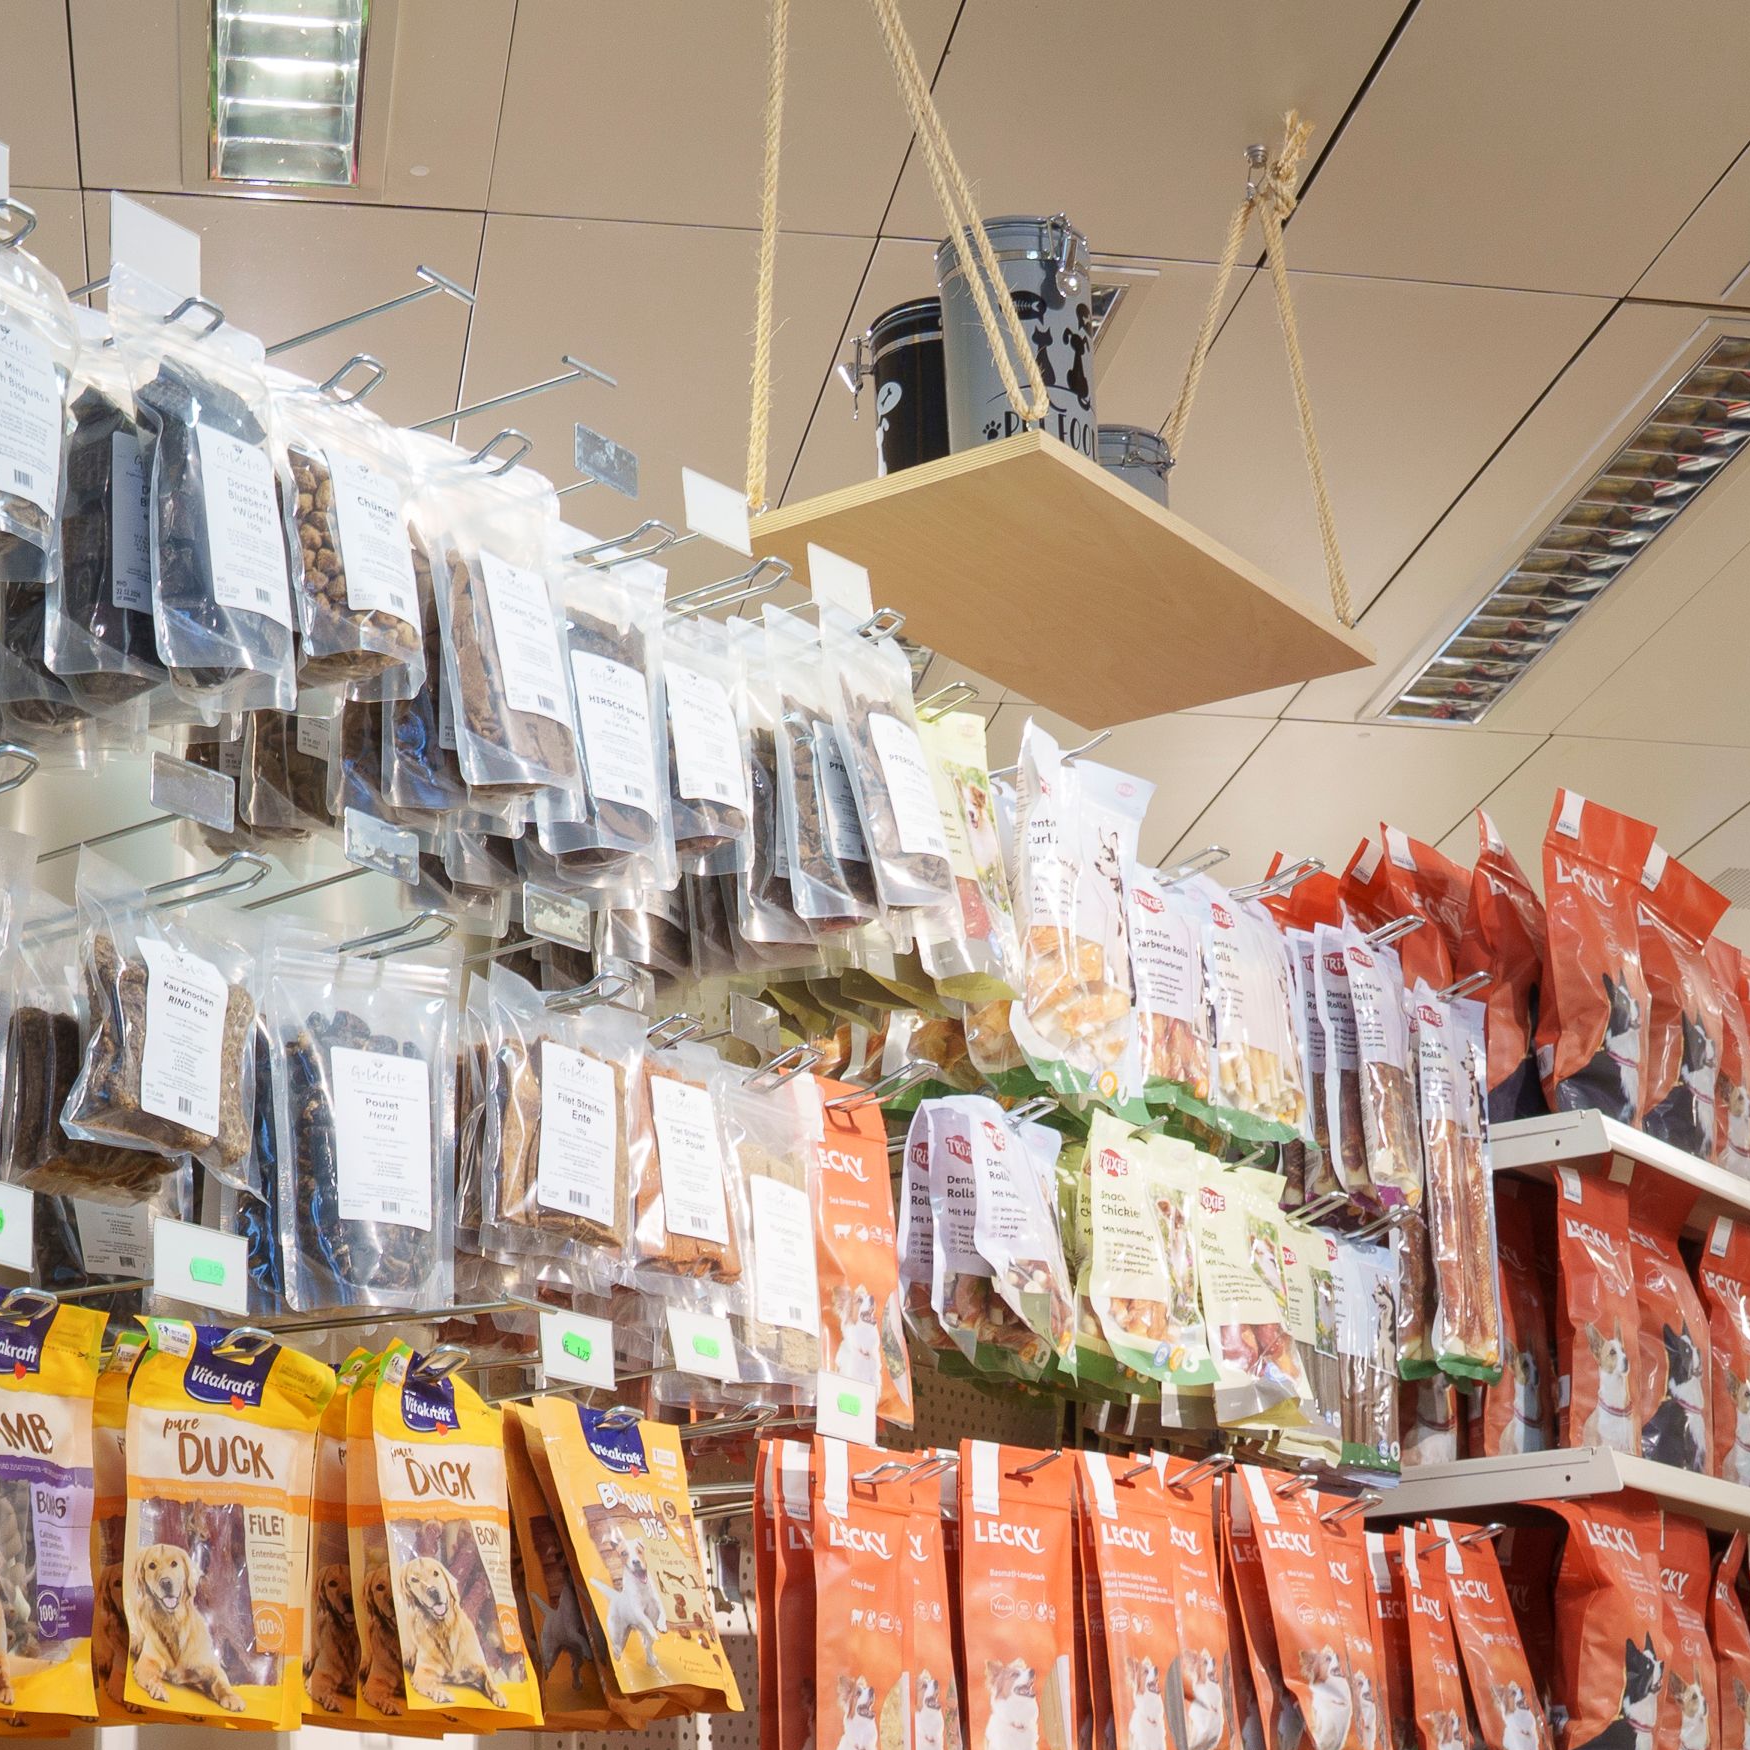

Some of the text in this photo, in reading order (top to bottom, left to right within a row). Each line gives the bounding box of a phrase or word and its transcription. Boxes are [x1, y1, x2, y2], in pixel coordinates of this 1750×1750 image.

[4, 360, 25, 379] Mini
[163, 980, 179, 993] Kau
[168, 996, 192, 1010] RIND
[365, 1098, 400, 1110] Poulet
[558, 1092, 605, 1118] Filet Streifen
[572, 1109, 592, 1126] Ente
[190, 1363, 257, 1396] Vitakraft
[163, 1415, 201, 1440] pure
[178, 1432, 275, 1480] DUCK
[406, 1459, 477, 1500] DUCK
[974, 1519, 1046, 1555] LECKY
[1101, 1523, 1156, 1558] LECKY
[1265, 1530, 1315, 1558] LECKY
[1582, 1520, 1642, 1561] LECKY
